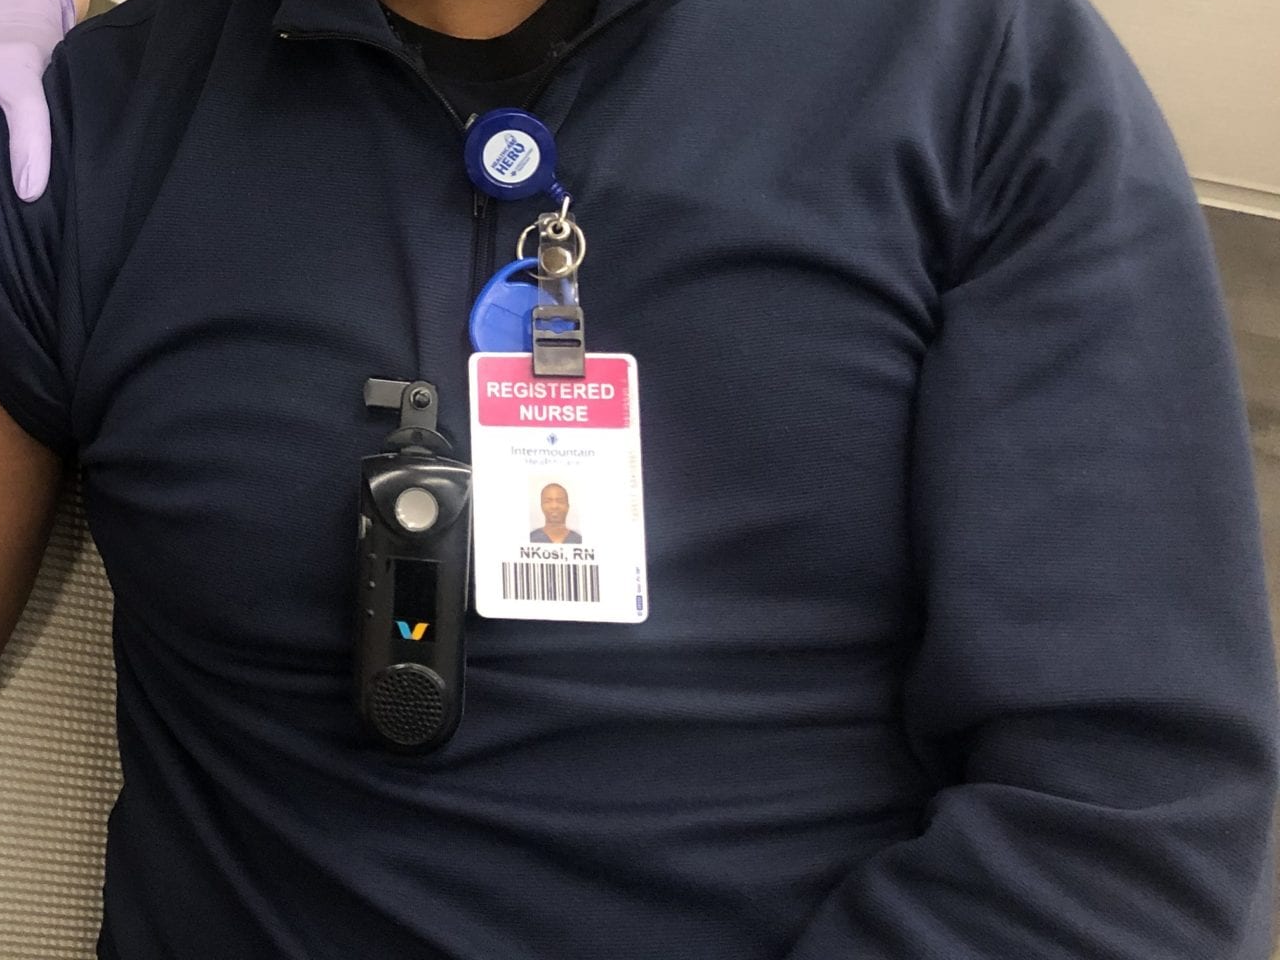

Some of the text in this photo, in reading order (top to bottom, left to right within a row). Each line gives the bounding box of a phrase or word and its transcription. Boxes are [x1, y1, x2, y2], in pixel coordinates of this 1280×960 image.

[496, 143, 525, 175] HERO
[486, 381, 615, 400] REGISTERED
[519, 404, 589, 422] NURSE
[511, 445, 595, 458] Intermountain
[520, 546, 595, 562] NKosi, RN
